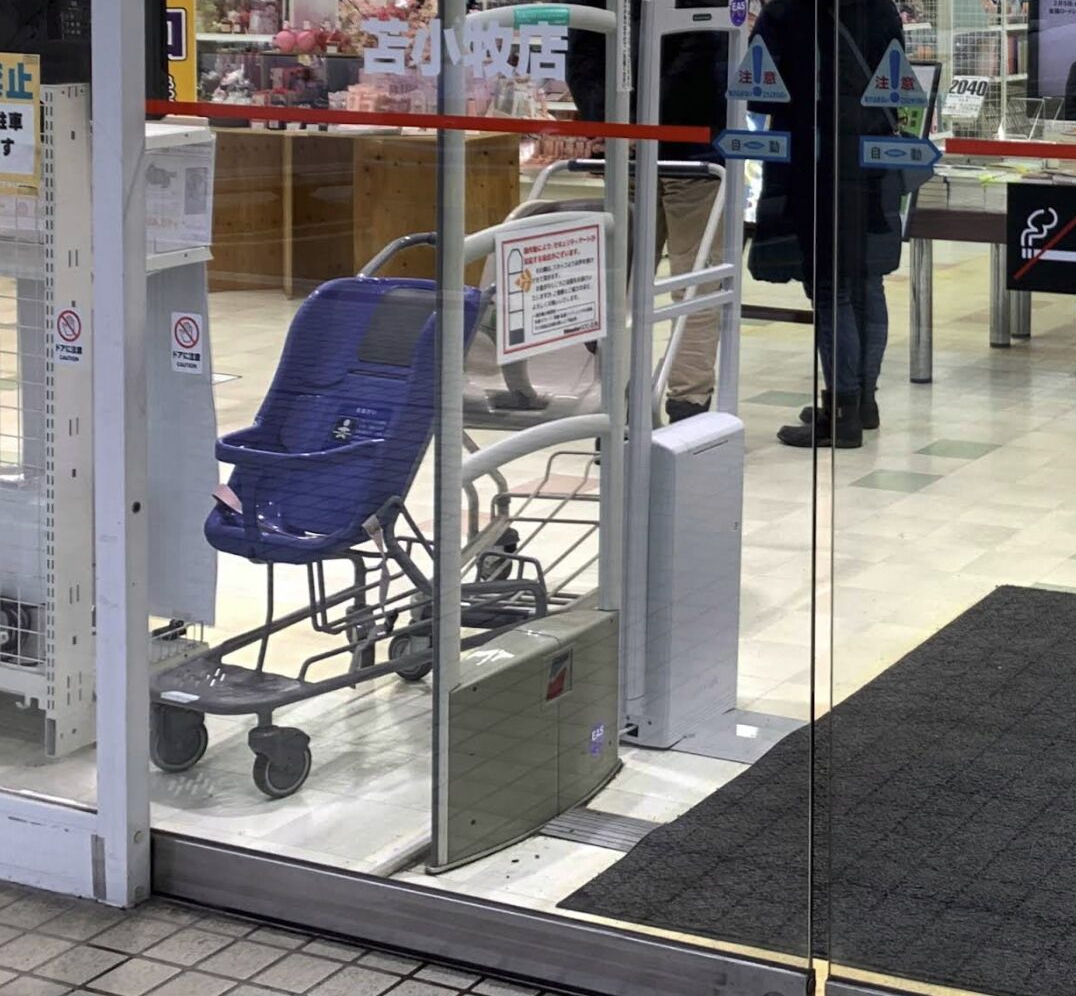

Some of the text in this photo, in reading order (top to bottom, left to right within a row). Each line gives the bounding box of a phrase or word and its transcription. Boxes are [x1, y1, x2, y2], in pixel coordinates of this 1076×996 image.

[732, 1, 746, 11] EAS
[362, 18, 569, 81] 苫小牧店
[0, 62, 34, 99] 止
[949, 79, 987, 97] 2040
[731, 140, 780, 153] 自動
[871, 146, 922, 160] 自動
[55, 343, 83, 354] ドアに注意
[59, 354, 79, 362] CAUTION
[172, 350, 201, 361] ドアに注意
[176, 361, 197, 369] CAUTION
[591, 725, 604, 741] EAS
